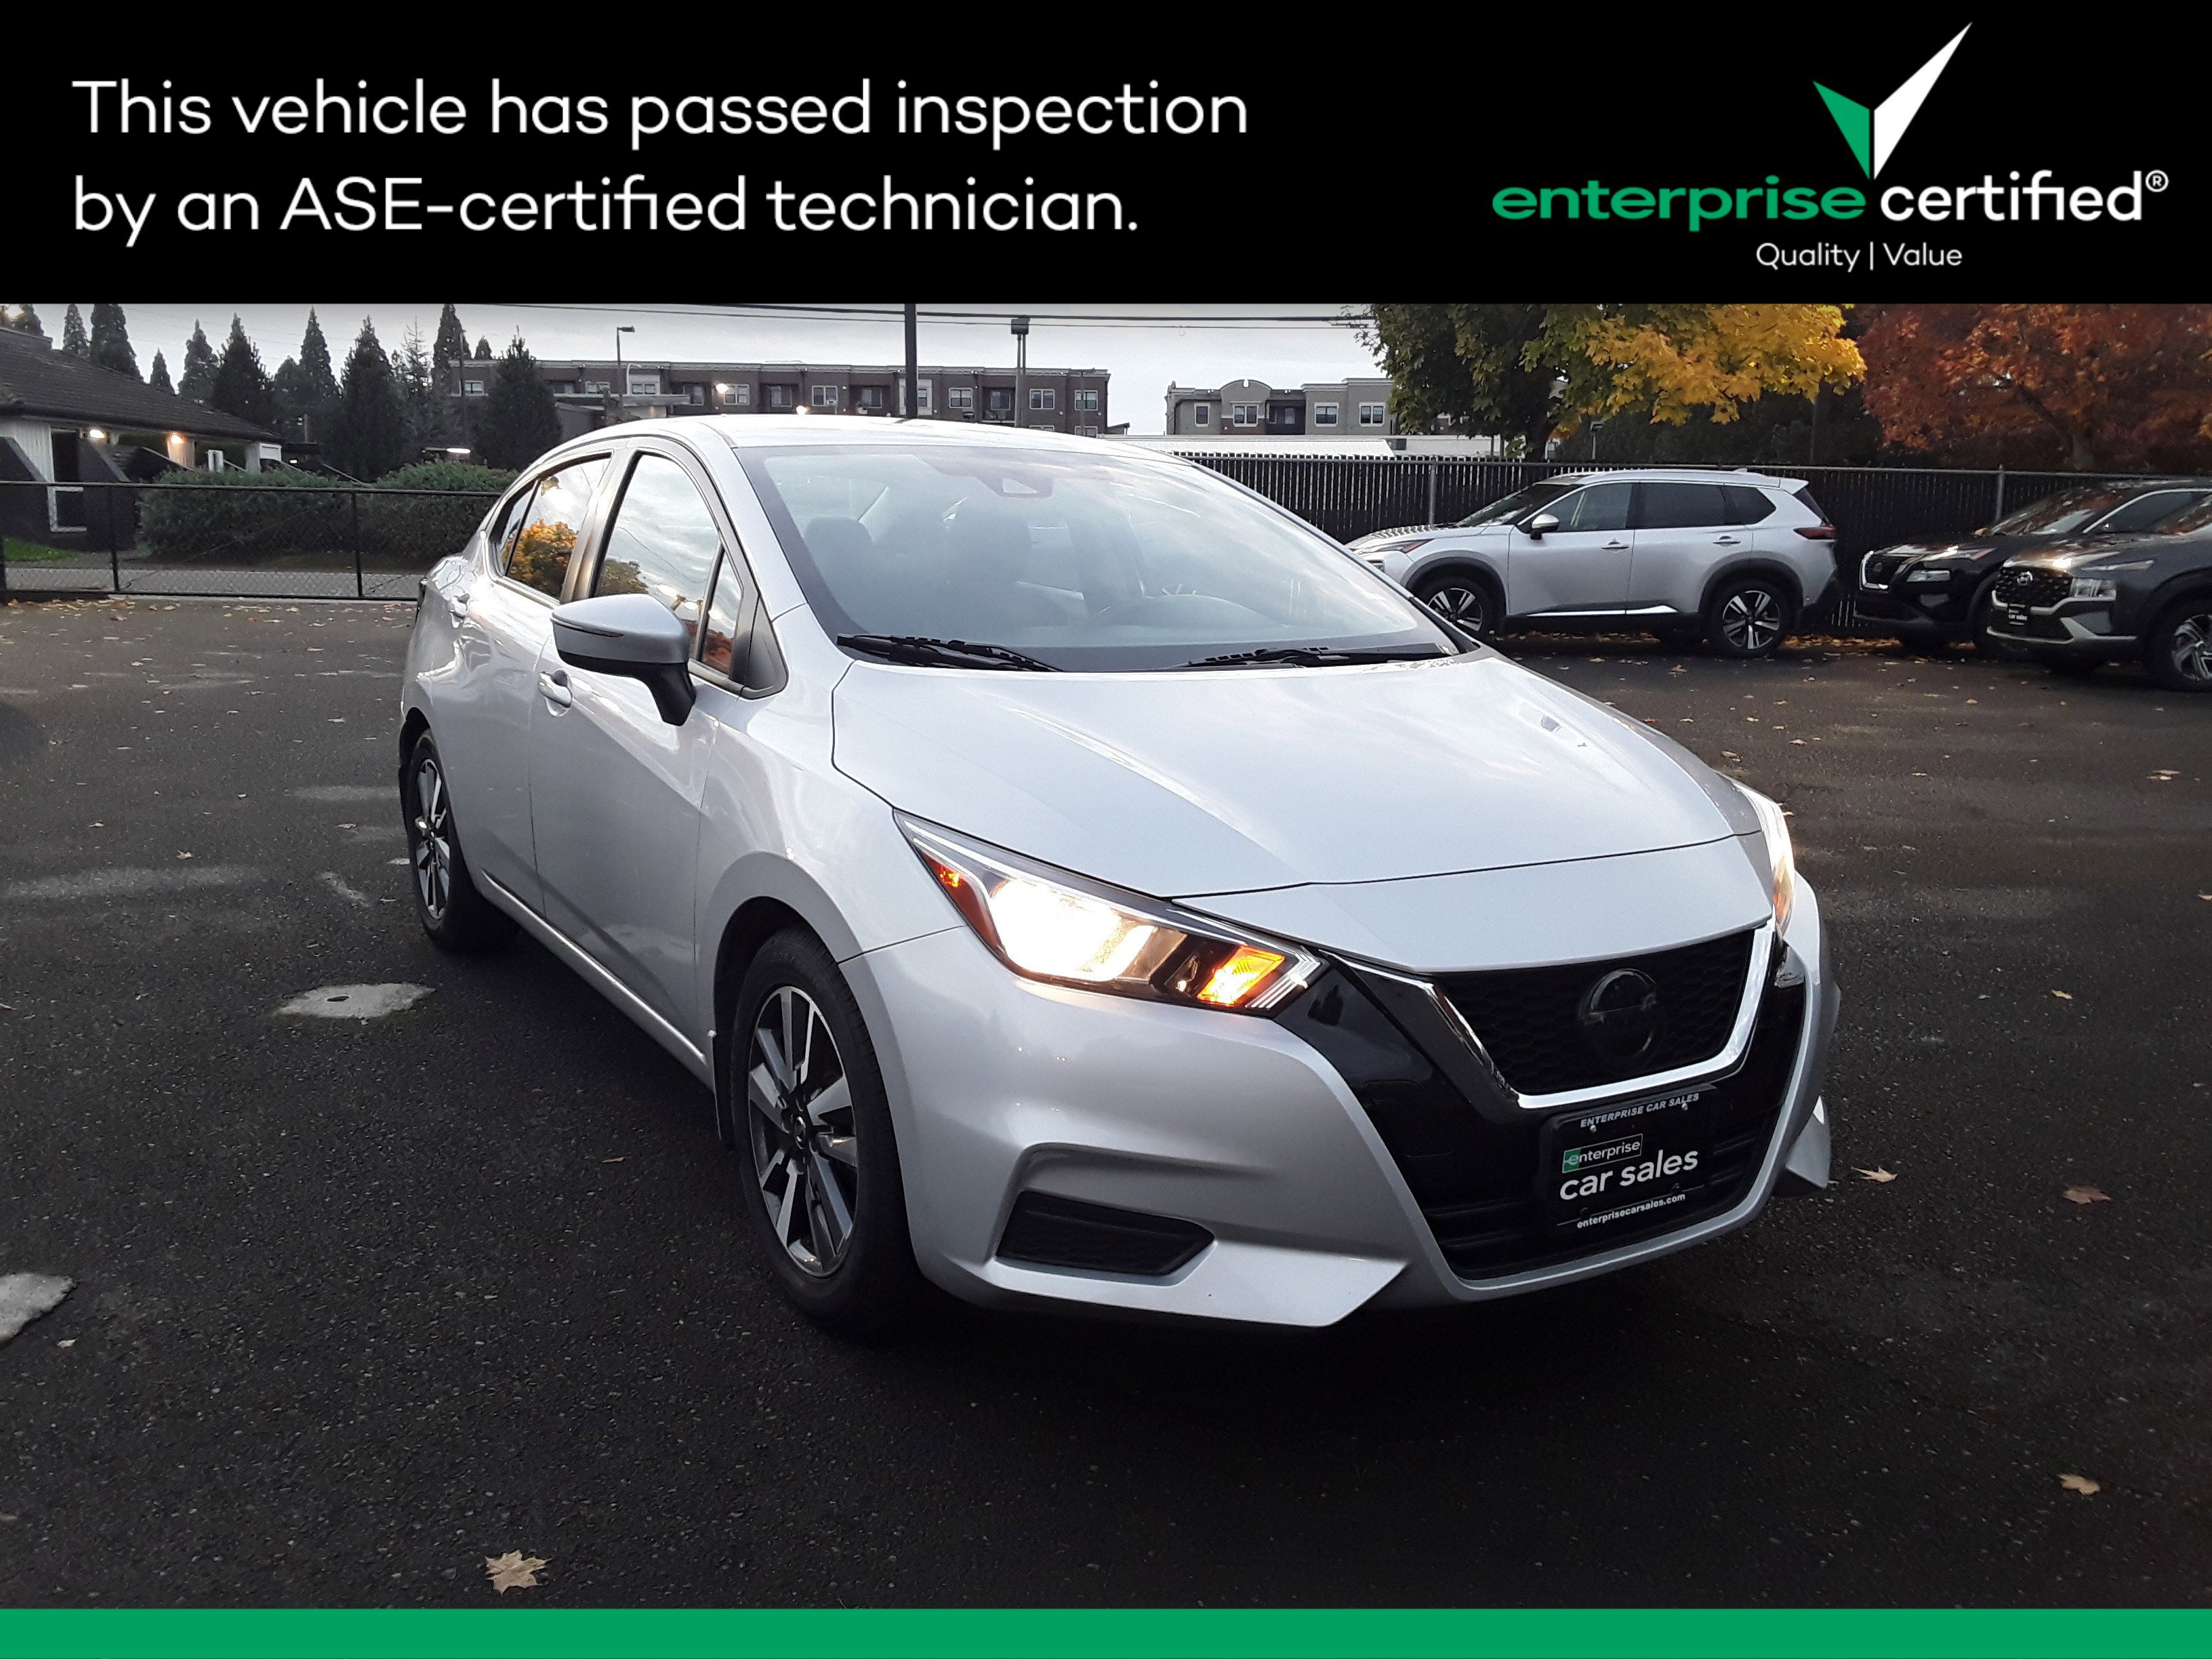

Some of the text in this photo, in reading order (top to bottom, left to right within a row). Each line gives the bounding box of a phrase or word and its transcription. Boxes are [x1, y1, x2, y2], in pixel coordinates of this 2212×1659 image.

[1580, 1092, 1700, 1128] ENTERPRISE CAR SALES
[1568, 1141, 1641, 1166] enterprise
[1559, 1149, 1698, 1200] car sales
[1576, 1193, 1686, 1229] enterprisecarsales.com
